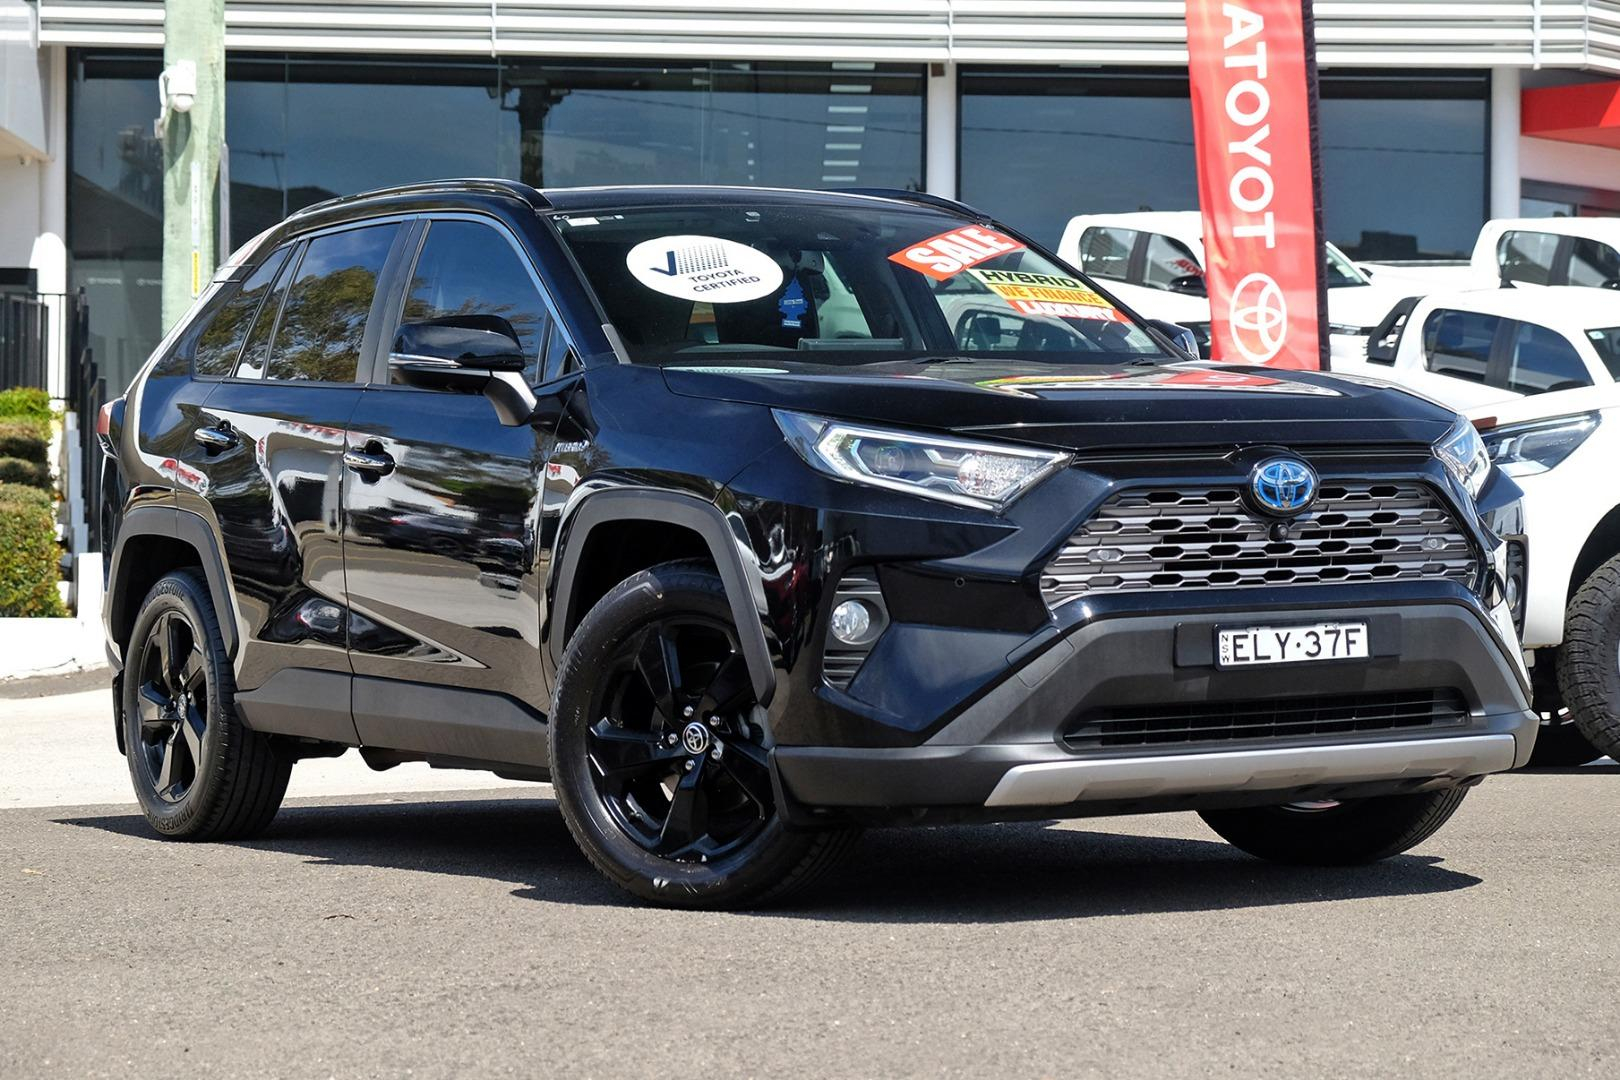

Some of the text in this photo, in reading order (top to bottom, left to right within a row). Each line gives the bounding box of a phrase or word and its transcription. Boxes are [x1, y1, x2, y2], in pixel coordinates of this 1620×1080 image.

[905, 228, 1015, 273] SALE
[688, 268, 744, 283] TOYOTA
[693, 276, 761, 293] CERTIFIED
[979, 270, 1080, 289] HYBRID
[996, 285, 1103, 304] WE FINANCE
